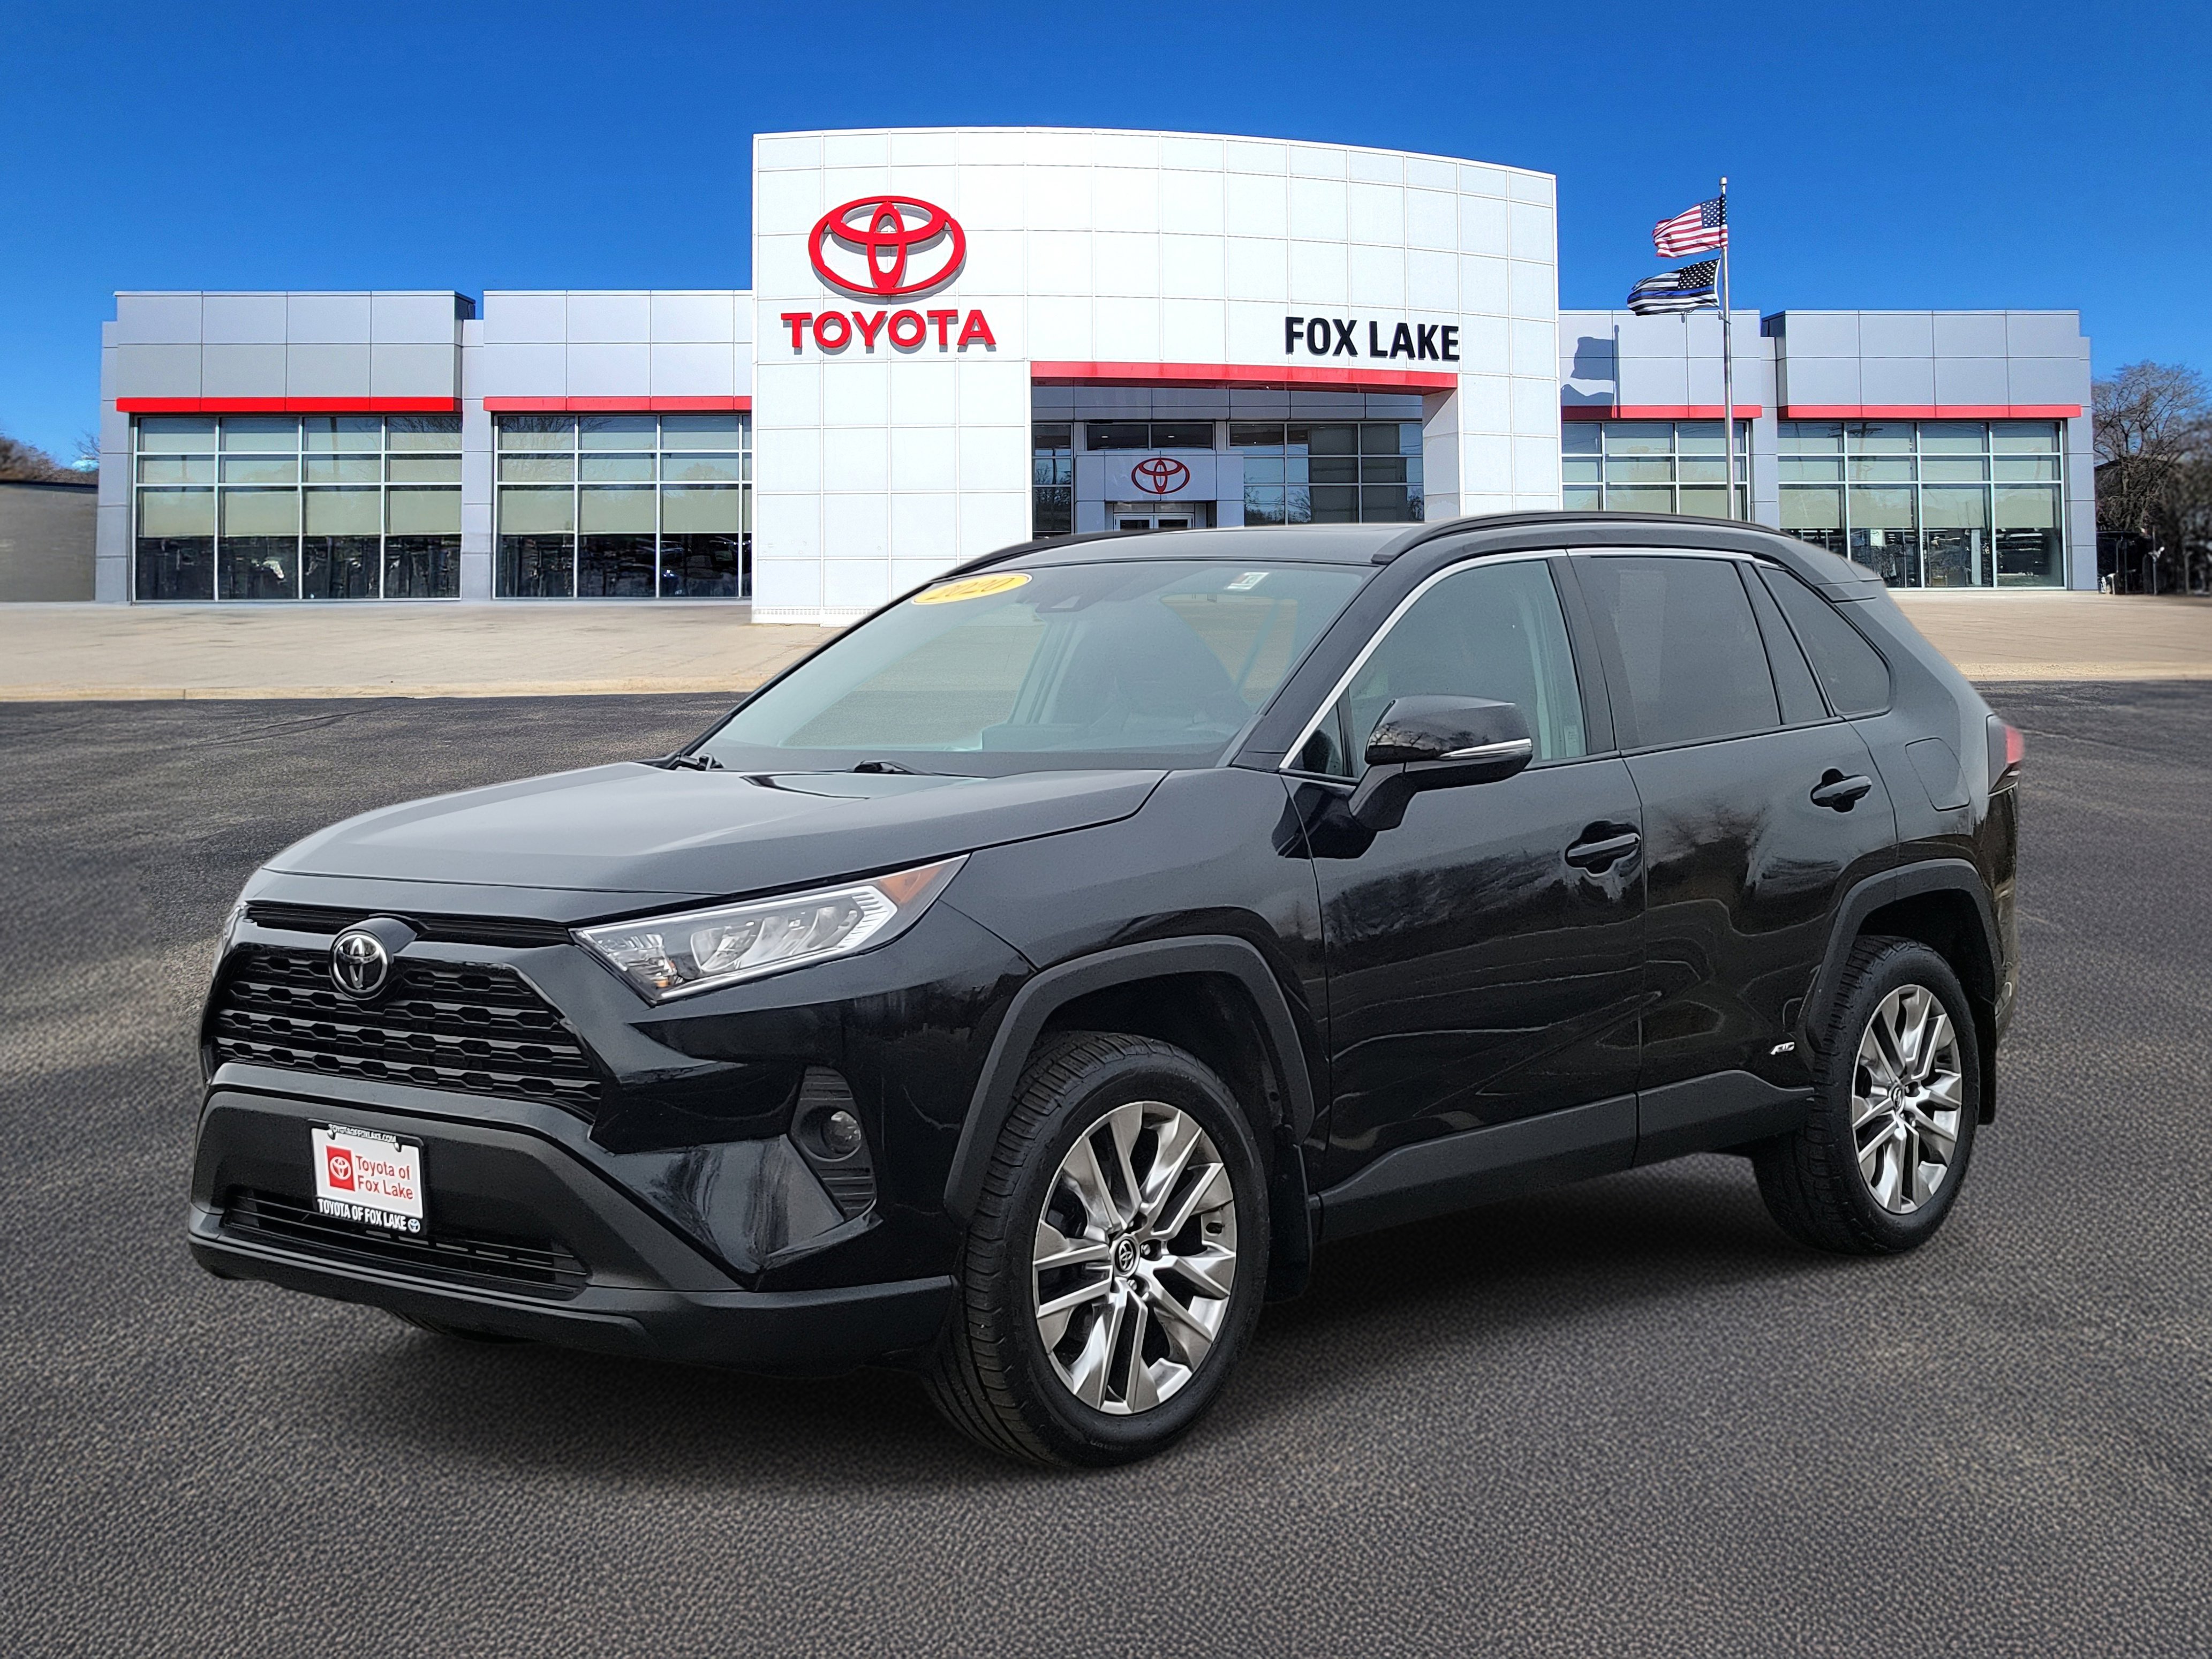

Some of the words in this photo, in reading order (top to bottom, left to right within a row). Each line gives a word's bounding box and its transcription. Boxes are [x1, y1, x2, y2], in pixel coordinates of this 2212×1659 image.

[781, 309, 996, 351] TOYOTA
[1285, 316, 1358, 356] FOX
[1369, 320, 1460, 361] LAKE
[355, 1155, 395, 1177] Toyota
[398, 1165, 410, 1180] of
[358, 1175, 380, 1194] Fox
[383, 1180, 413, 1200] Lake
[318, 1198, 351, 1219] TOYOTA
[351, 1205, 364, 1221] OF
[365, 1206, 383, 1227] FOX
[383, 1213, 407, 1231] LAKE
